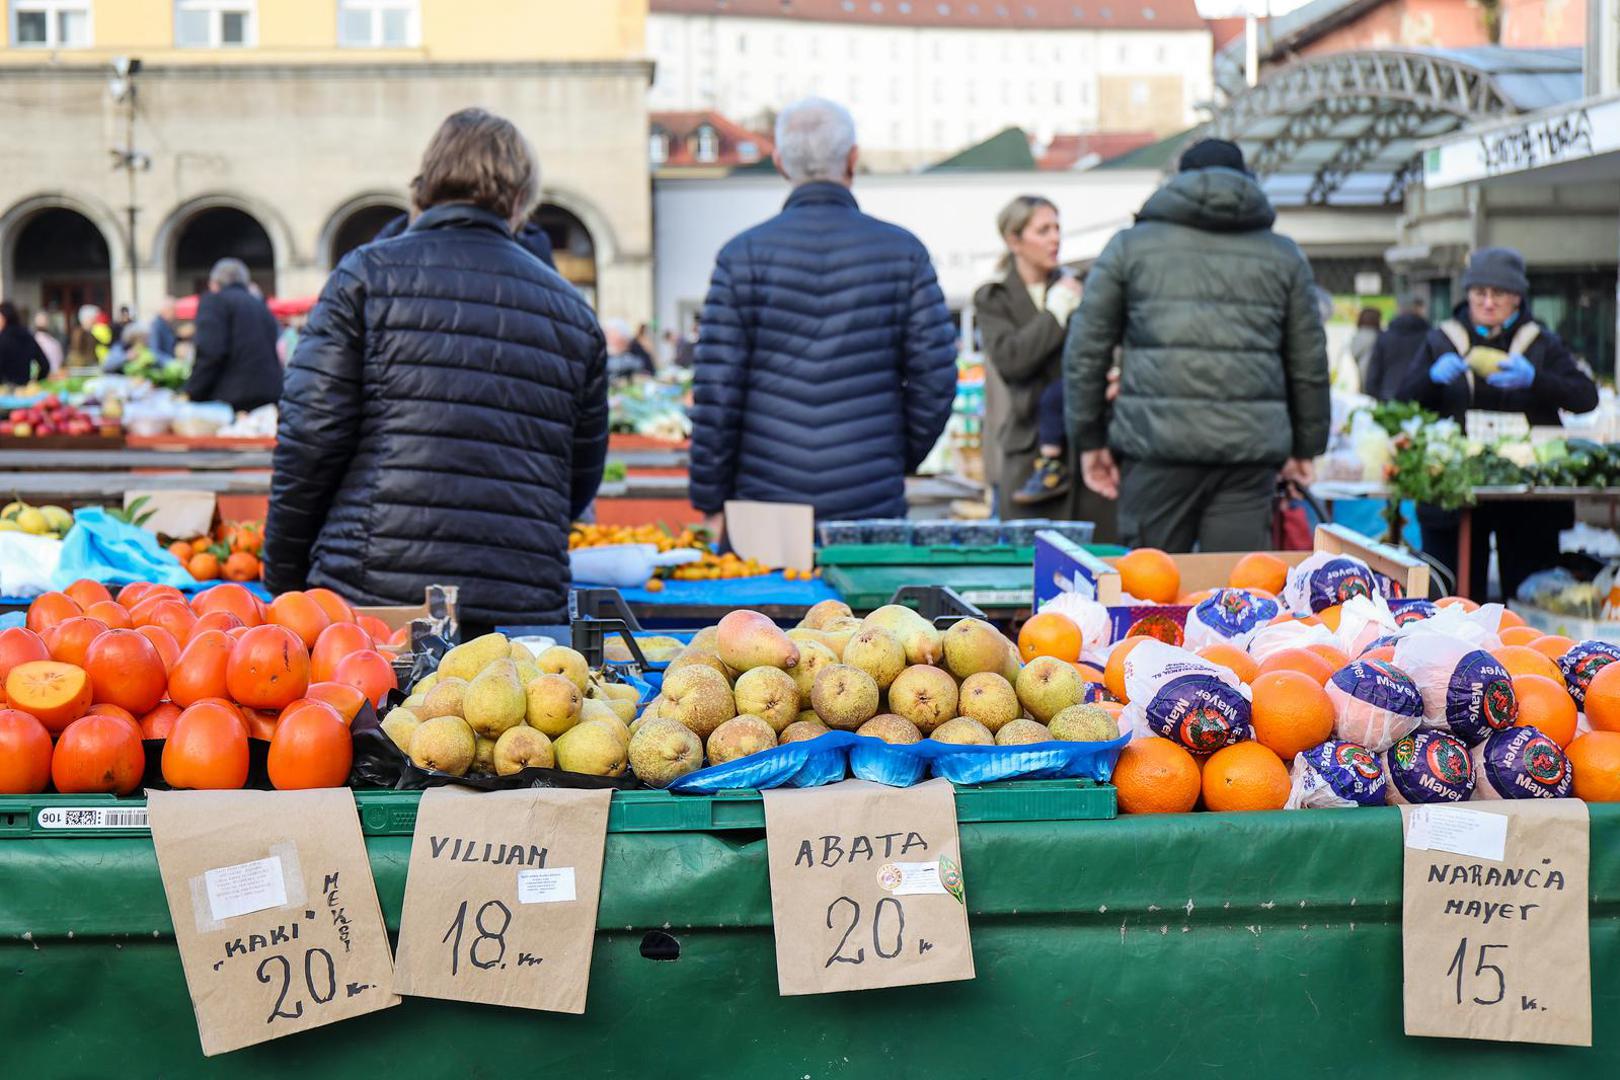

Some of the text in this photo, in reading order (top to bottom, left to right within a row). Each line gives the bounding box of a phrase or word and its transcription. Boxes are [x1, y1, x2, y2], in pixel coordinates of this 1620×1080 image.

[1376, 675, 1416, 699] Mayer
[1195, 689, 1238, 721] Mayer
[1503, 729, 1532, 768] Mayer
[1419, 773, 1463, 801] Mayer
[1515, 773, 1554, 799] Mayer
[42, 812, 61, 823] 106
[794, 831, 928, 868] ABATA
[825, 896, 904, 969] 20
[256, 948, 336, 1024] 20
[1447, 937, 1508, 1006] 15
